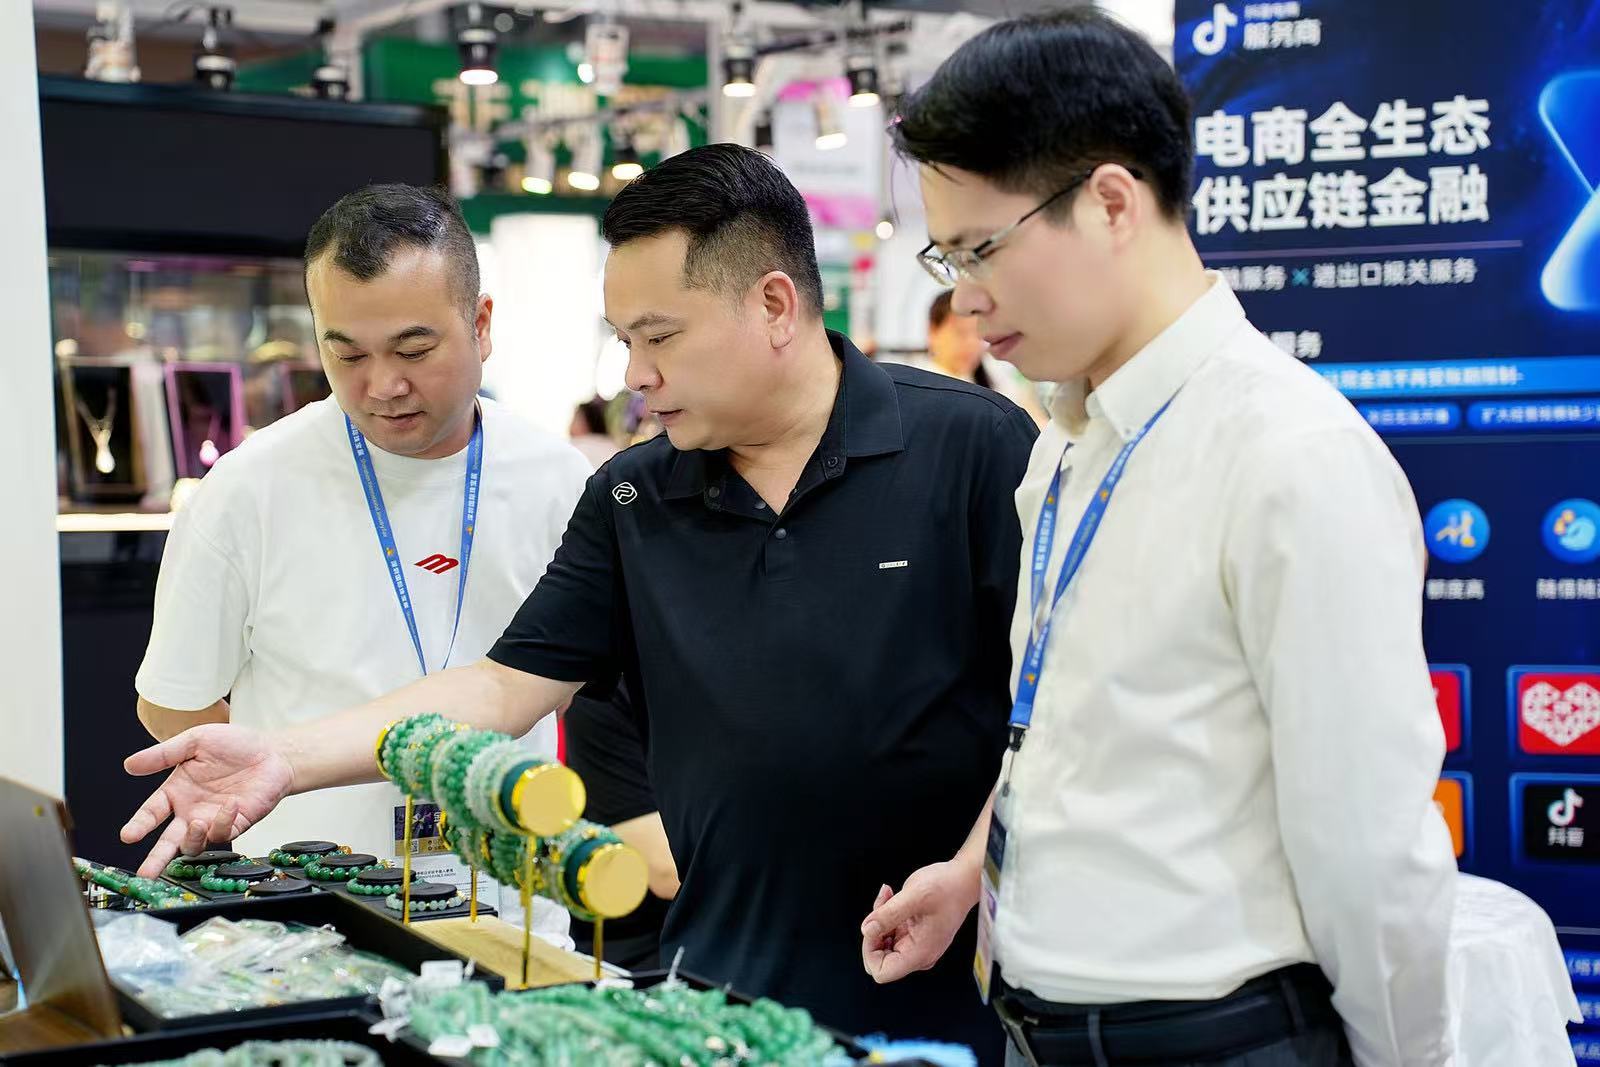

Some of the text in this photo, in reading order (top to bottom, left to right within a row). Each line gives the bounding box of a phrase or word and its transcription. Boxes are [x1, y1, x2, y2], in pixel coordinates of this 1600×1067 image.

[1195, 95, 1491, 167] 电商全生态
[1192, 164, 1489, 235] 供应链金融
